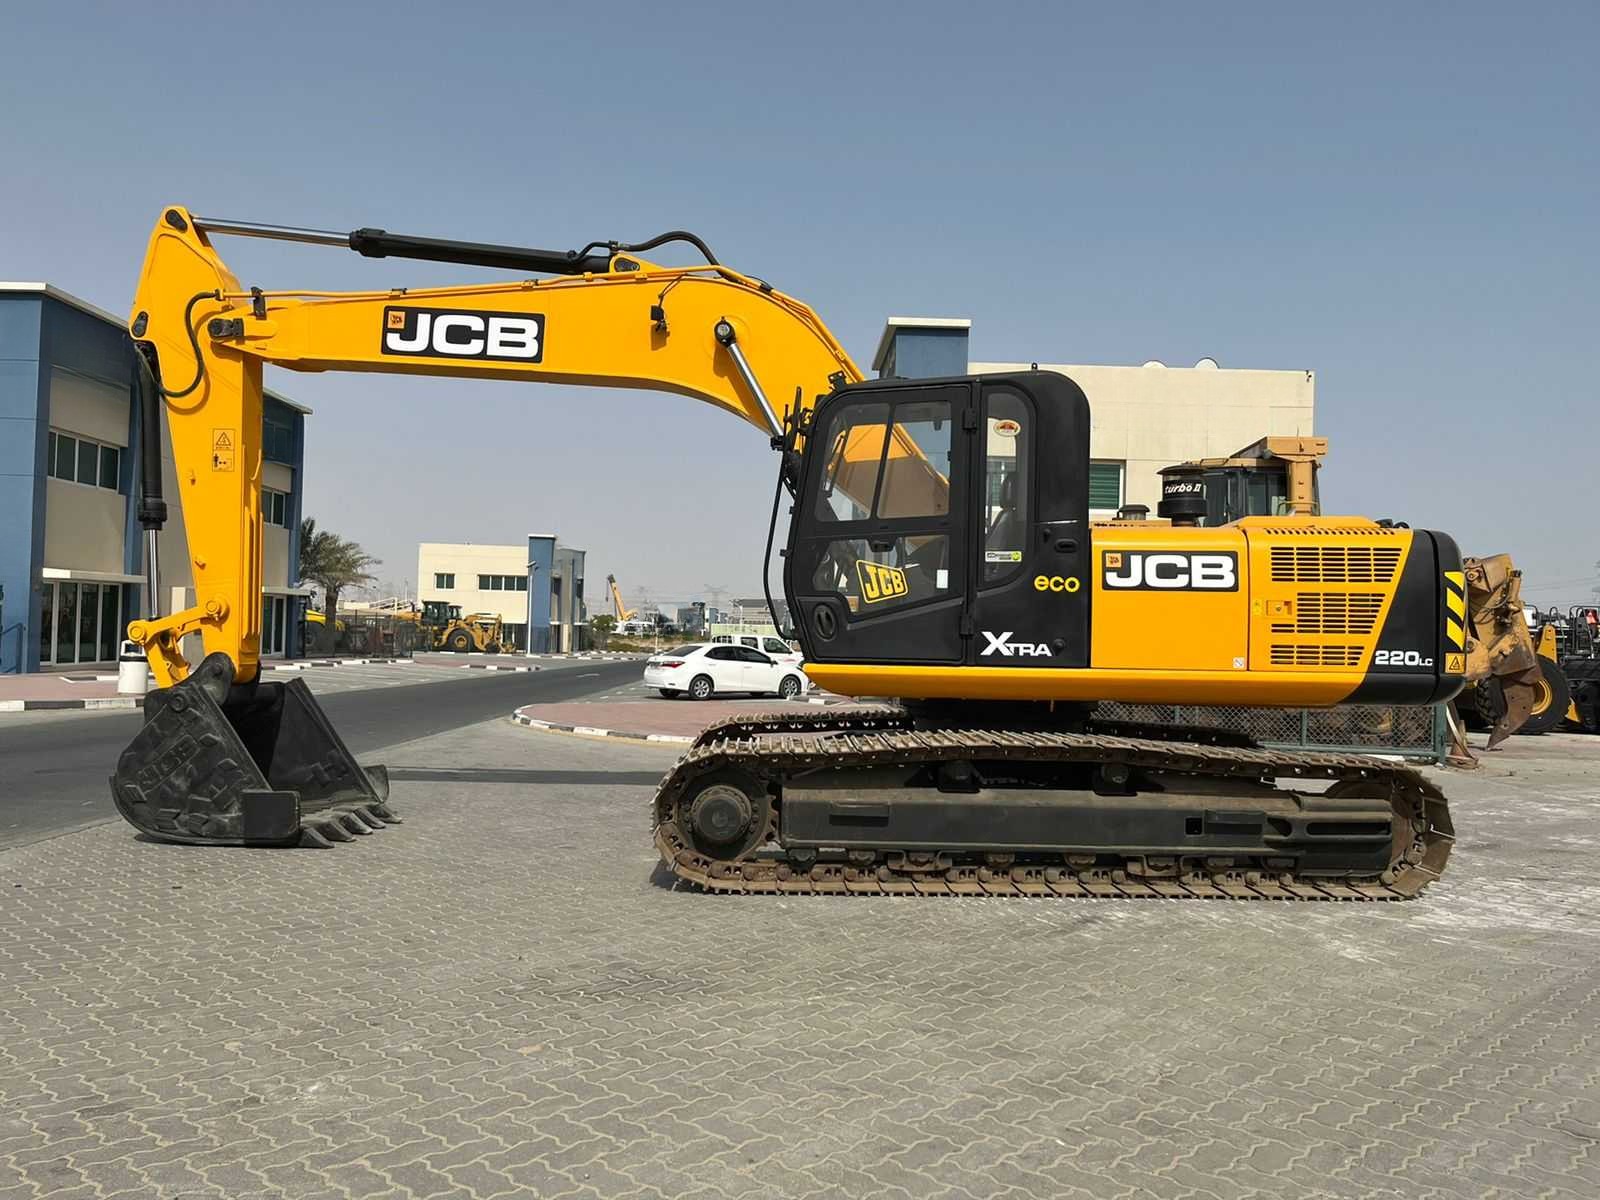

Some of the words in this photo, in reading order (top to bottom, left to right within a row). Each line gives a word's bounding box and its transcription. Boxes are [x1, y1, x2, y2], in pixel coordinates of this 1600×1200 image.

[386, 313, 539, 358] JCB
[1164, 483, 1193, 494] turbo
[865, 565, 905, 598] JCB
[1034, 575, 1080, 592] eco
[1105, 554, 1235, 588] JCB
